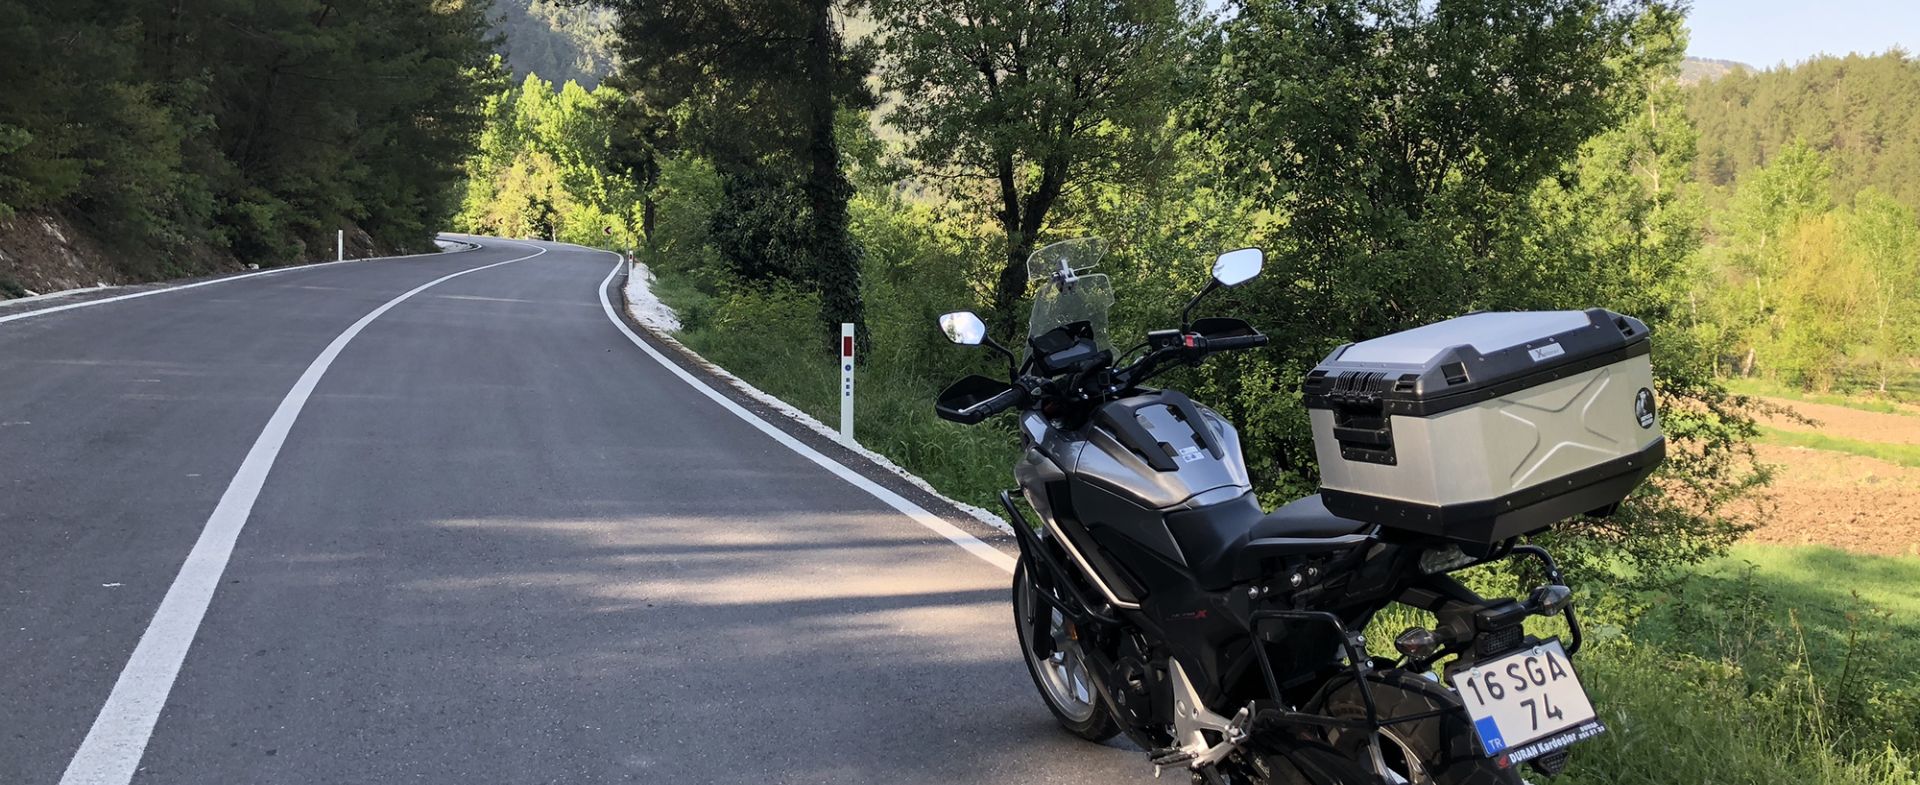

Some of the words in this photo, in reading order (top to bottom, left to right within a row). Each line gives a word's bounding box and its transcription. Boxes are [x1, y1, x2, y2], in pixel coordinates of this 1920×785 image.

[1467, 671, 1504, 706] 16
[1506, 651, 1567, 691] SGA
[1520, 693, 1563, 731] 74
[1488, 738, 1503, 750] TR
[1509, 746, 1538, 763] DURAN
